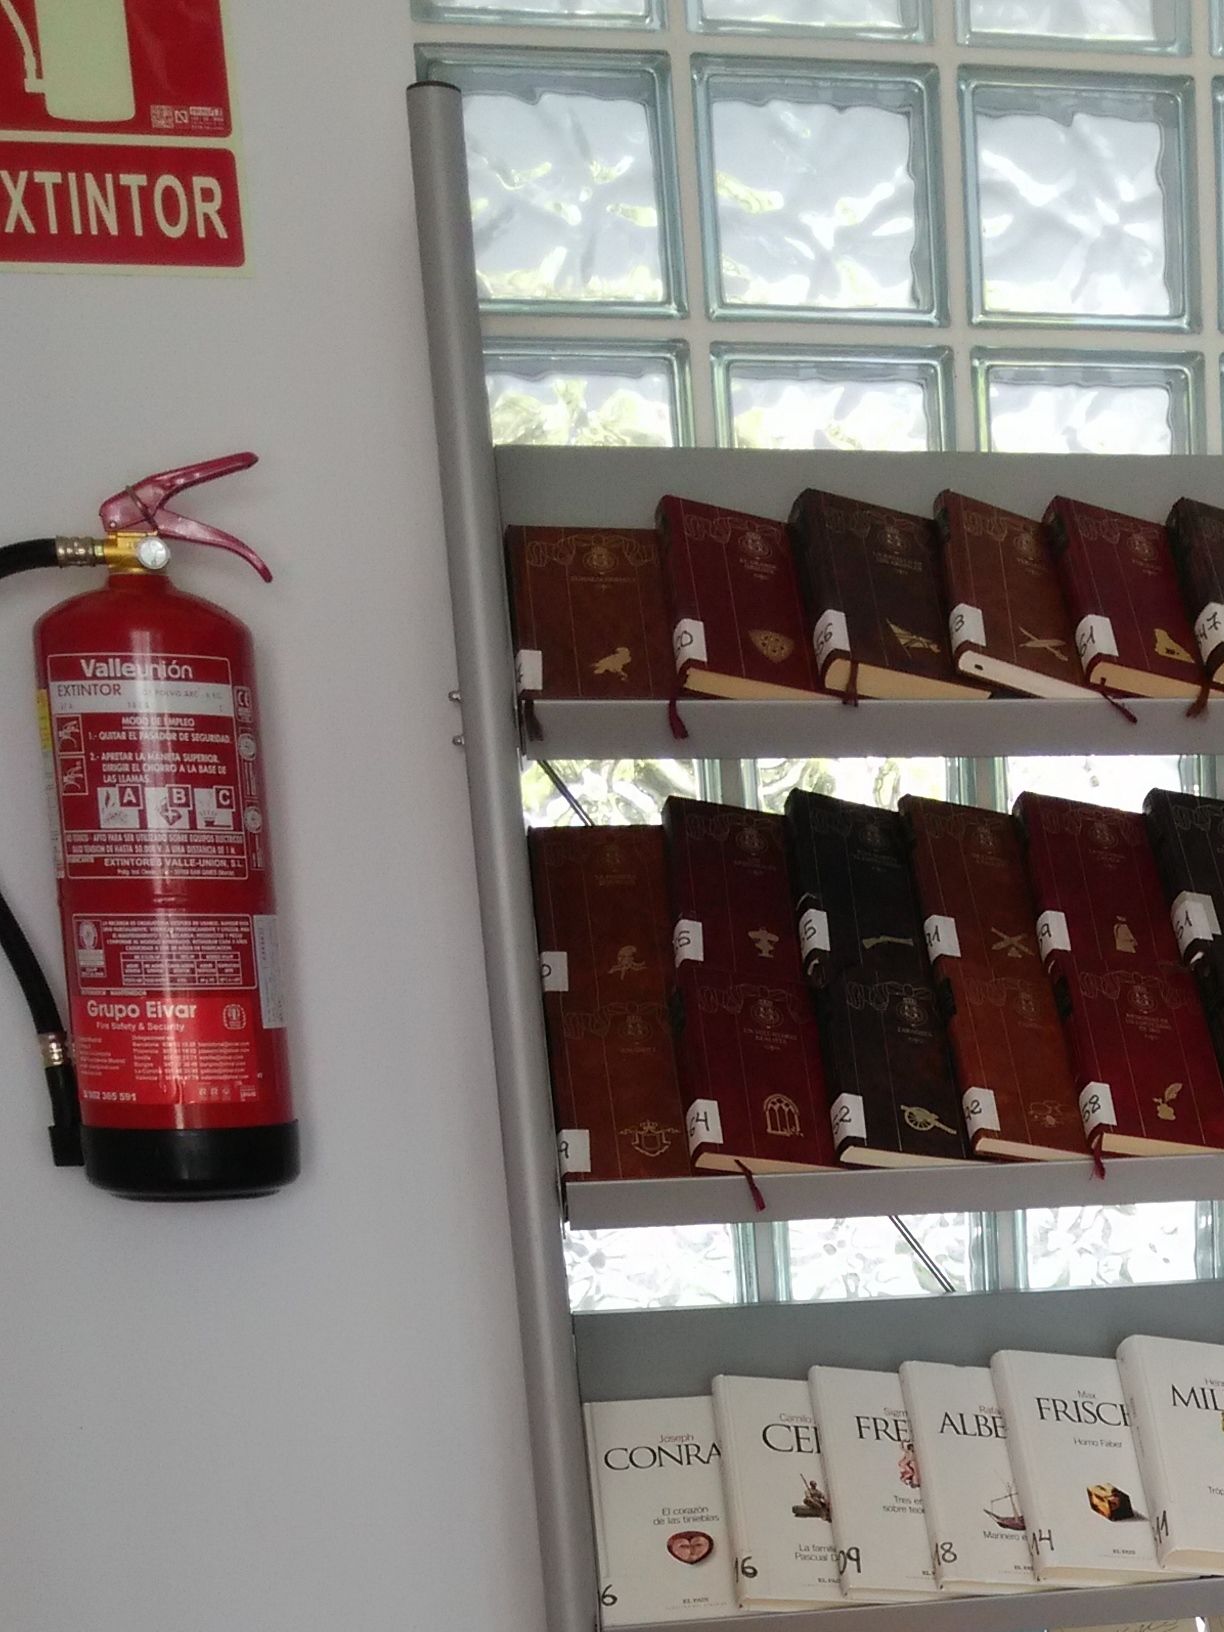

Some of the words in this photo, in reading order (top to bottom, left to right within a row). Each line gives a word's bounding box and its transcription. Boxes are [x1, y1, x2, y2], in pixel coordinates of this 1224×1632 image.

[0, 170, 229, 240] XTINTOR
[57, 683, 122, 698] EXTINTOR
[128, 731, 138, 741] EL
[179, 733, 190, 742] DE
[178, 764, 186, 774] A
[186, 764, 197, 774] LA
[198, 764, 218, 775] BASE
[123, 787, 137, 803] A
[173, 788, 187, 804] B
[219, 789, 231, 805] C
[87, 1000, 140, 1021] Grupo
[146, 1000, 197, 1019] Eivar
[147, 1022, 185, 1032] Security
[603, 1441, 723, 1472] CONRA
